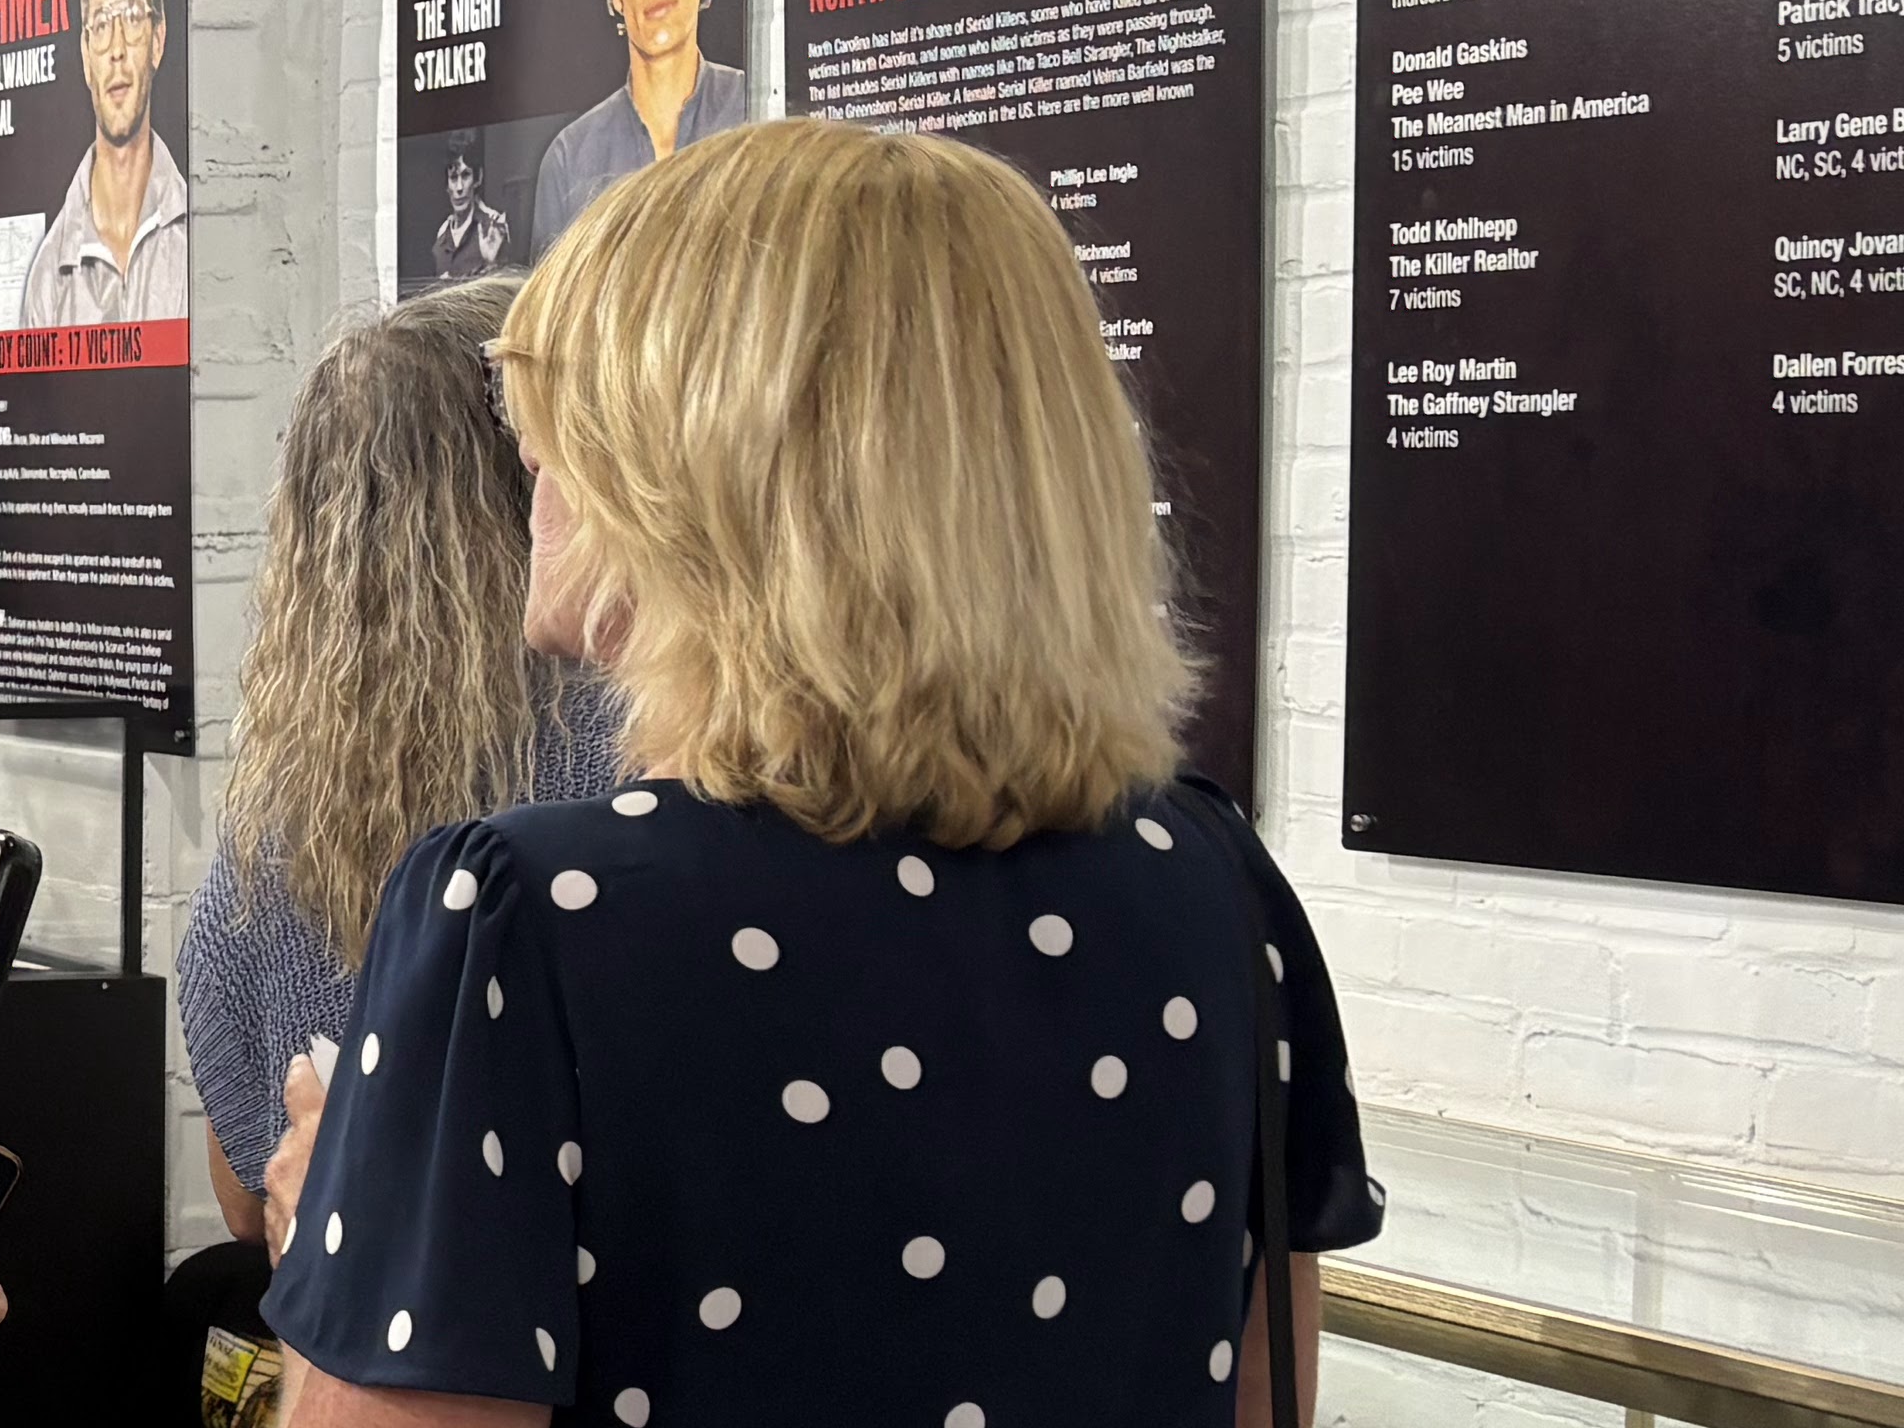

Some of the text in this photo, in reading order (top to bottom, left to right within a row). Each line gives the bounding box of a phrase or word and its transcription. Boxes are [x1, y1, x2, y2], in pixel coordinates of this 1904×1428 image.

[1392, 37, 1528, 73] Donald Gaskins
[1777, 32, 1864, 62] 5 victims
[414, 41, 486, 93] STALKER
[1392, 79, 1465, 106] Pee Wee
[1391, 91, 1650, 139] The Meanest Man in America
[1777, 118, 1830, 145] Larry
[1835, 112, 1888, 139] Gene
[1392, 145, 1474, 172] 15 victims
[1776, 148, 1865, 181] NC, SC, 4
[1390, 217, 1518, 245] Todd Kohlhepp
[1389, 247, 1539, 278] The Killer Realtor
[1774, 235, 1844, 262] Quincy
[1389, 286, 1461, 311] 7 victims
[1774, 268, 1863, 300] SC, NC, 4
[17, 332, 64, 368] COUNT:
[68, 332, 82, 363] 17
[85, 328, 142, 363] VICTIMS
[1388, 357, 1517, 386] Lee Roy Martin
[1773, 352, 1837, 378] Dallen
[1387, 388, 1577, 419] The Gaffney Strangler
[1772, 389, 1858, 414] 4 victims
[1387, 426, 1459, 449] 4 victims
